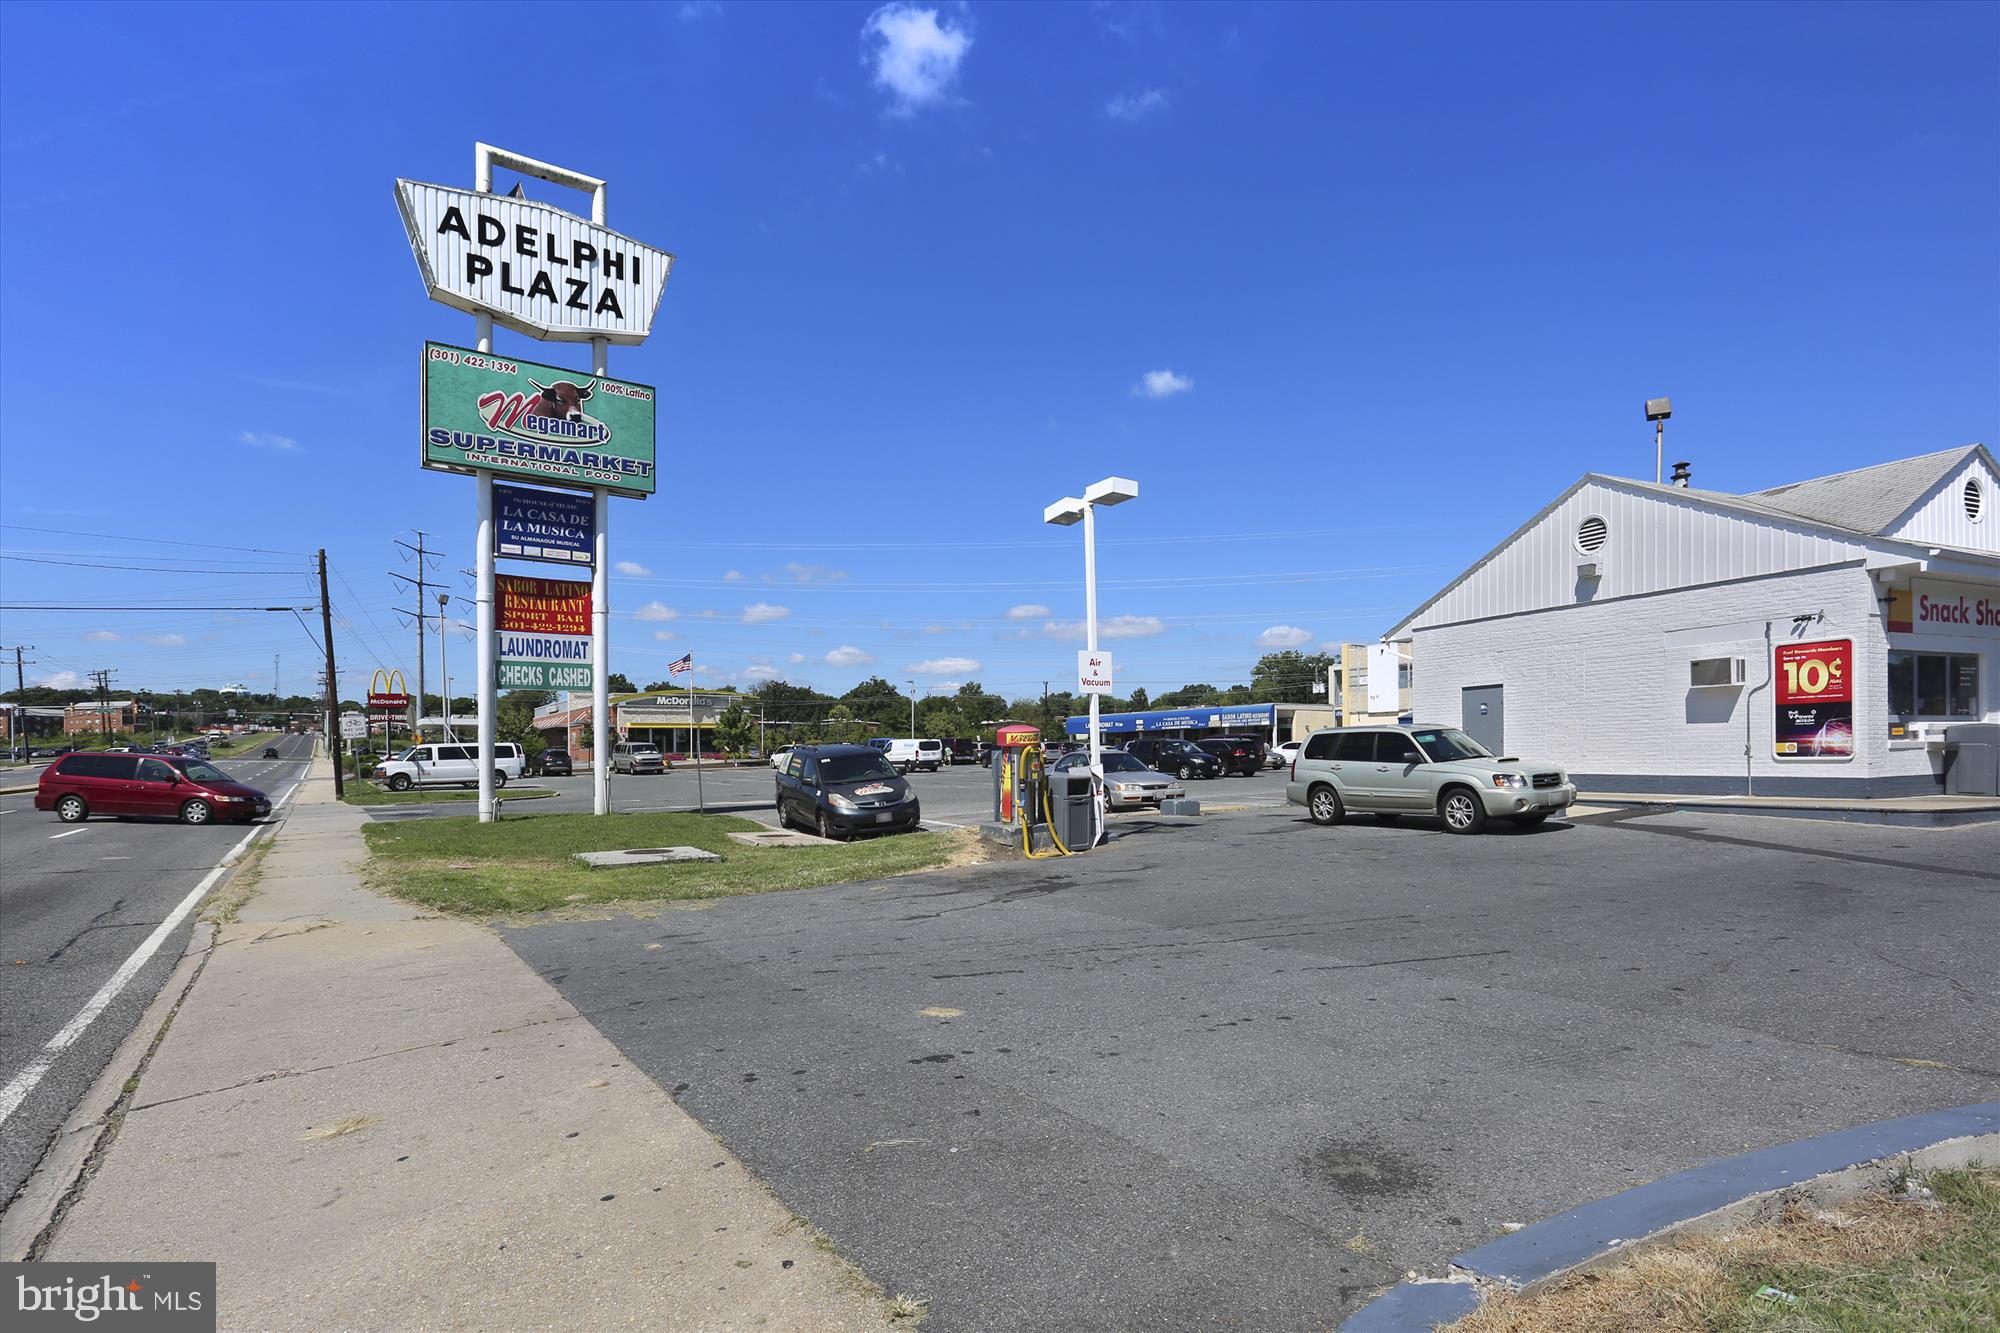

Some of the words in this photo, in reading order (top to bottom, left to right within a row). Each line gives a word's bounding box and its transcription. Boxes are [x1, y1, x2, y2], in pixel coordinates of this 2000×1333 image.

[437, 206, 640, 284] ADELPHI
[466, 253, 623, 319] PLAZA
[429, 348, 460, 364] (301)
[463, 356, 517, 374] 422-1394
[600, 382, 623, 395] 100%
[625, 386, 651, 400] Latino
[429, 428, 653, 477] SUPERMARKET
[466, 452, 579, 475] INTERNATIONAL
[585, 470, 621, 481] FOOD
[503, 506, 523, 518] LA
[527, 509, 566, 523] CASA
[570, 514, 589, 526] DE
[503, 520, 523, 532] LA
[527, 523, 585, 539] MUSICA
[498, 577, 537, 594] SABOR
[545, 582, 588, 598] LATINO
[504, 594, 585, 613] RESTAURANT
[1920, 594, 1970, 624] Snack
[504, 610, 548, 621] SPORT
[557, 614, 583, 622] BAR
[500, 637, 588, 660] LAUNDROMAT
[1089, 658, 1101, 666] Air
[499, 664, 543, 686] CHECKS
[549, 667, 591, 687] CASHED
[1081, 678, 1110, 687] Vacuum
